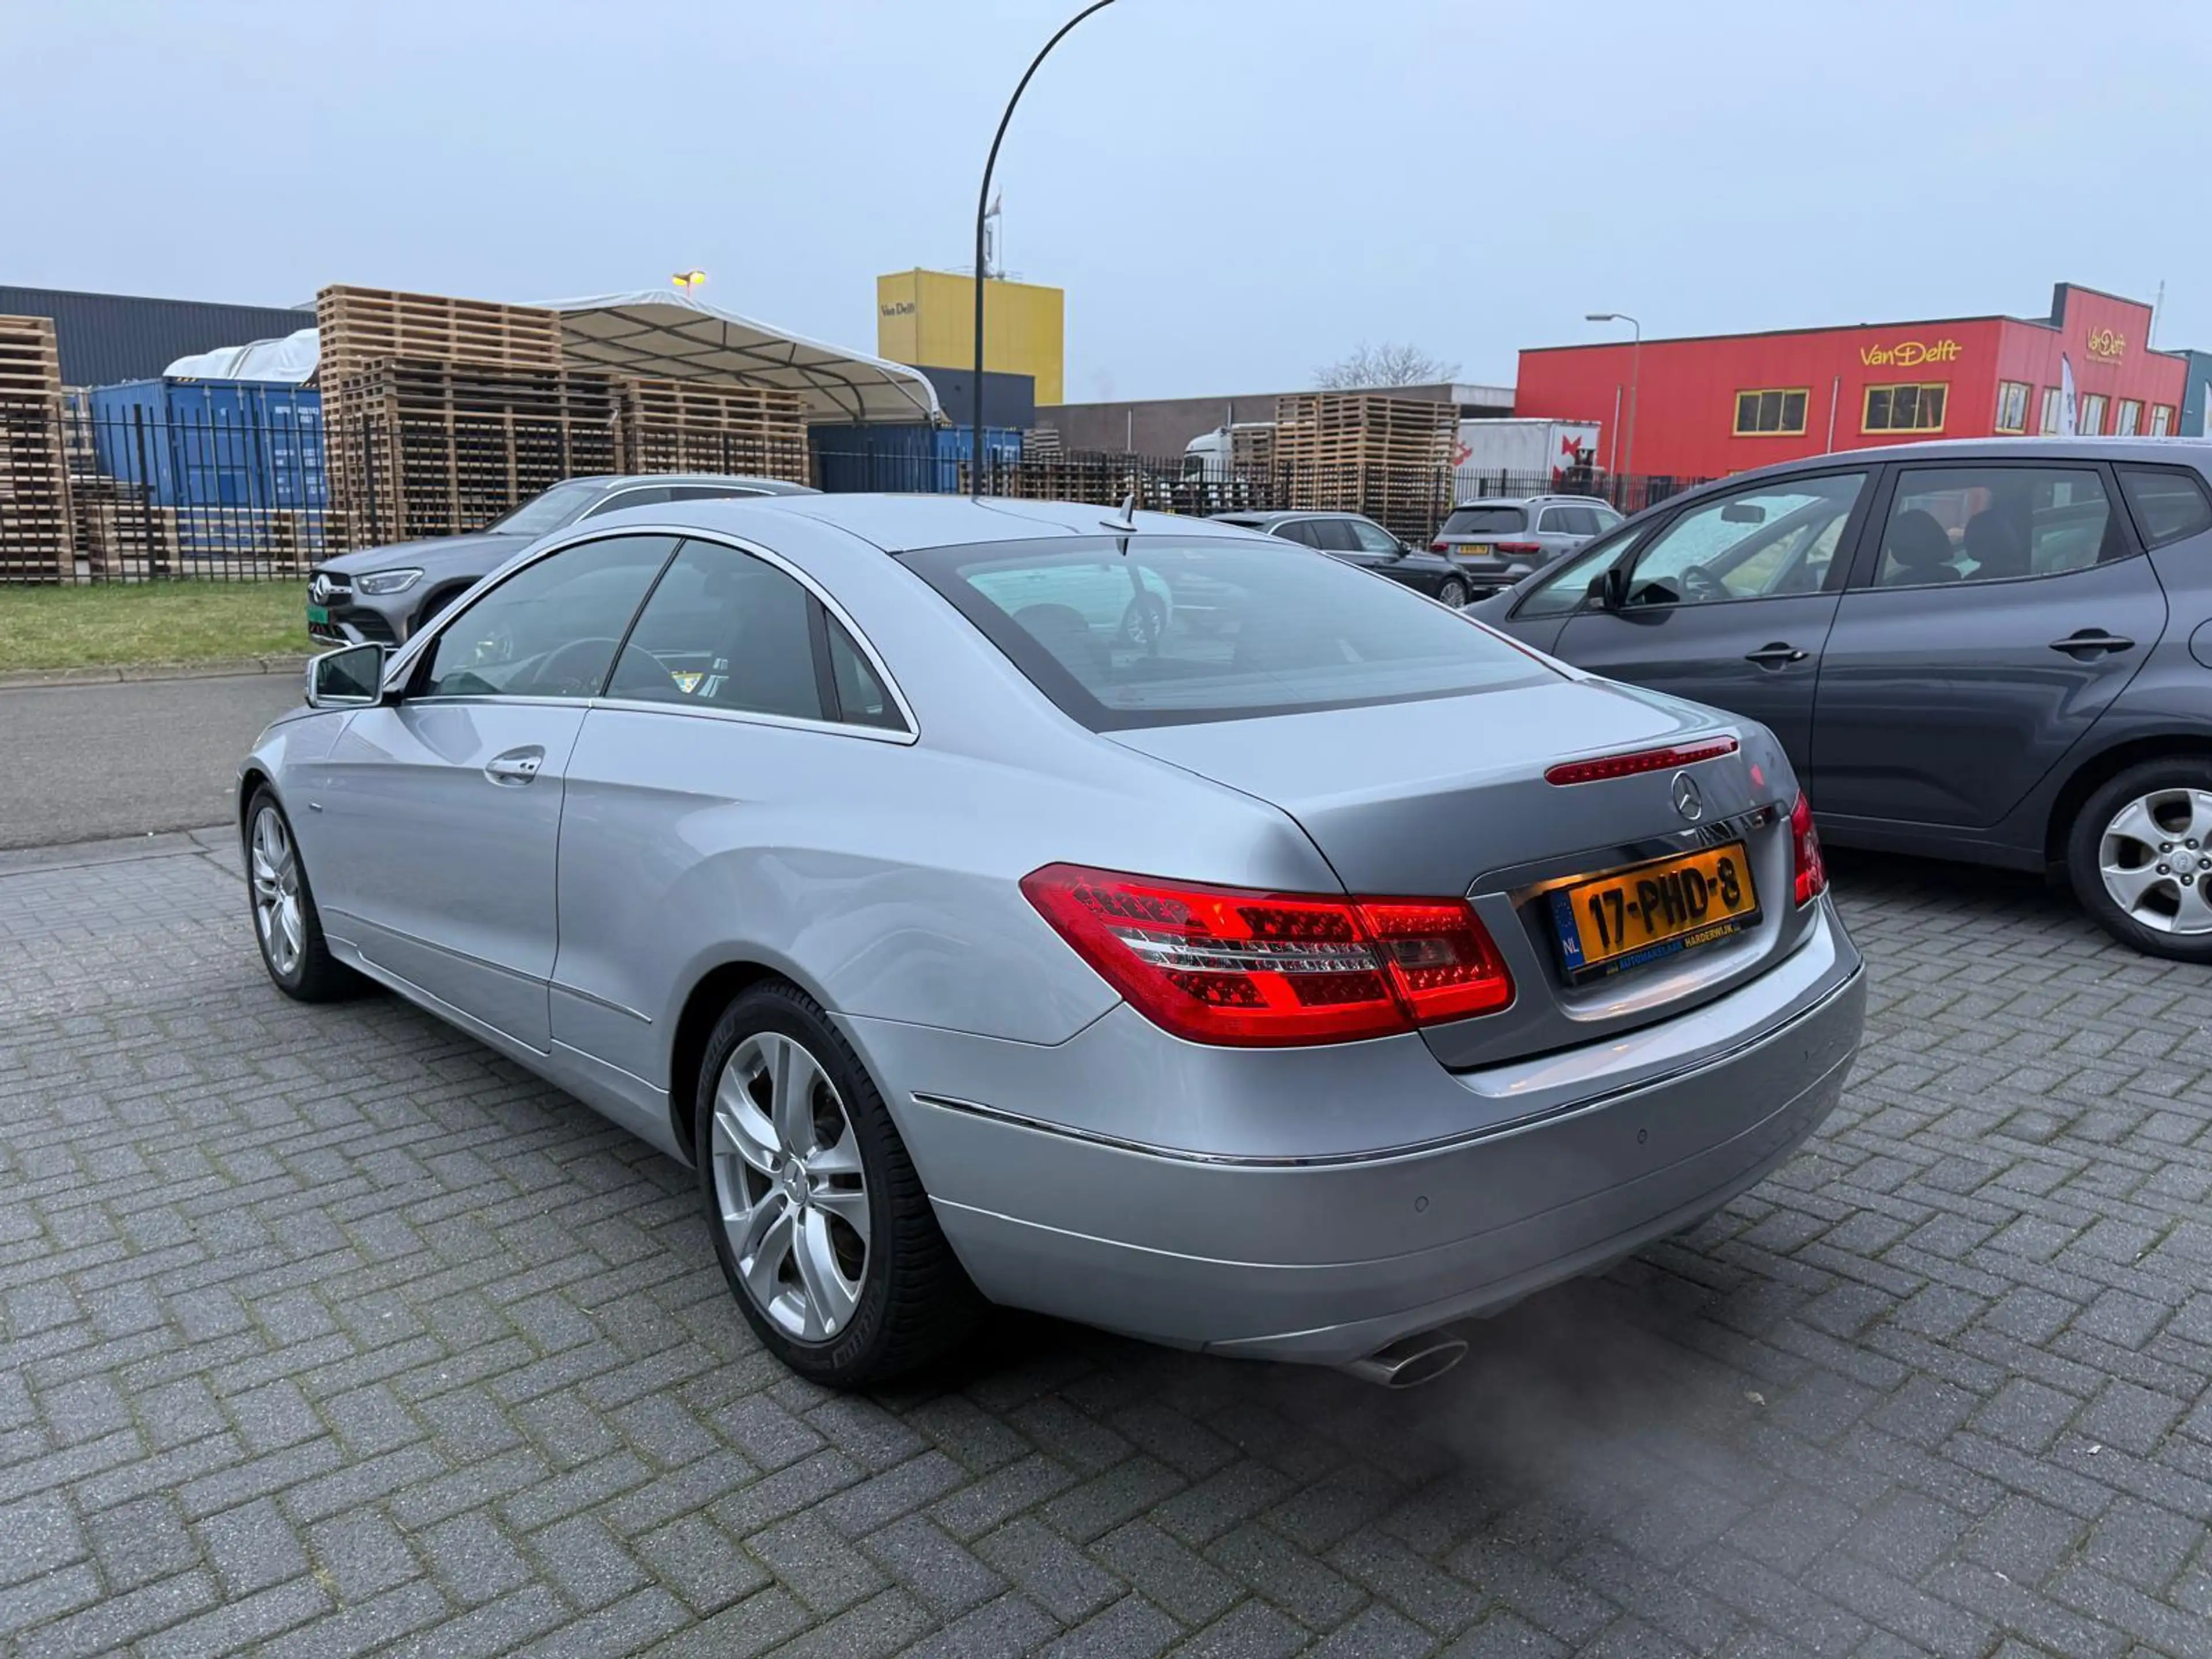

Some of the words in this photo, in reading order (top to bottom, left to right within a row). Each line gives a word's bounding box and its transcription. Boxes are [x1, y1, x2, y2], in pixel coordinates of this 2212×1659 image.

[1588, 856, 1741, 949] 17-PHD-8
[1562, 940, 1580, 956] NL
[1684, 923, 1736, 948] HARDERWIJK
